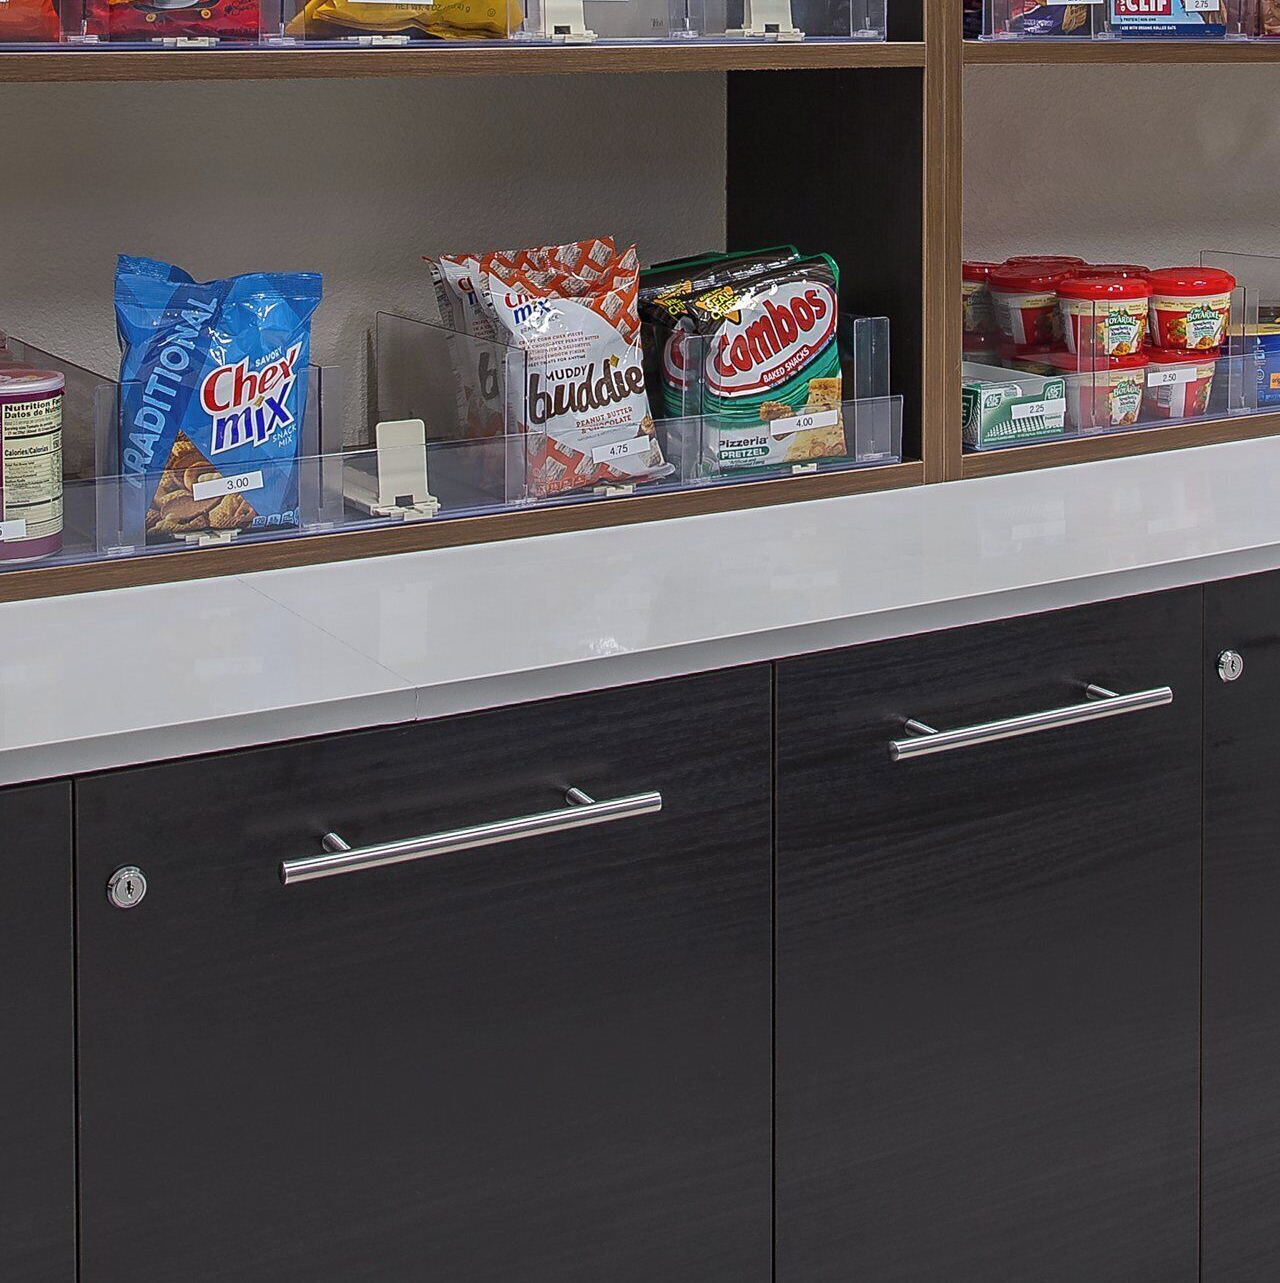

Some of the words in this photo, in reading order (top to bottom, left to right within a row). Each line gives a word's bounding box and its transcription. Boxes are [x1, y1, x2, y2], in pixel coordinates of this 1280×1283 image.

[1194, 0, 1209, 9] 2.75
[712, 288, 828, 377] Combos
[254, 346, 283, 368] SAVORY
[762, 370, 786, 384] BAKED
[784, 348, 811, 373] SNACKS
[202, 346, 300, 413] Chex
[546, 365, 588, 383] MUDDY
[1162, 373, 1177, 383] 2.50
[121, 296, 218, 489] TRADITIONAL
[4, 401, 51, 412] Nutrition
[1029, 404, 1045, 414] 2.25
[4, 410, 32, 419] Datos
[214, 382, 292, 452] mix
[575, 416, 606, 428] PEANUT
[606, 407, 633, 419] BUTTER
[795, 418, 814, 428] 4.00
[272, 424, 297, 443] SNACK
[278, 436, 294, 448] MIX
[719, 436, 768, 448] Pizzeria
[609, 443, 628, 456] 4.75
[721, 449, 766, 460] PRETZEL
[227, 477, 250, 490] 3.00
